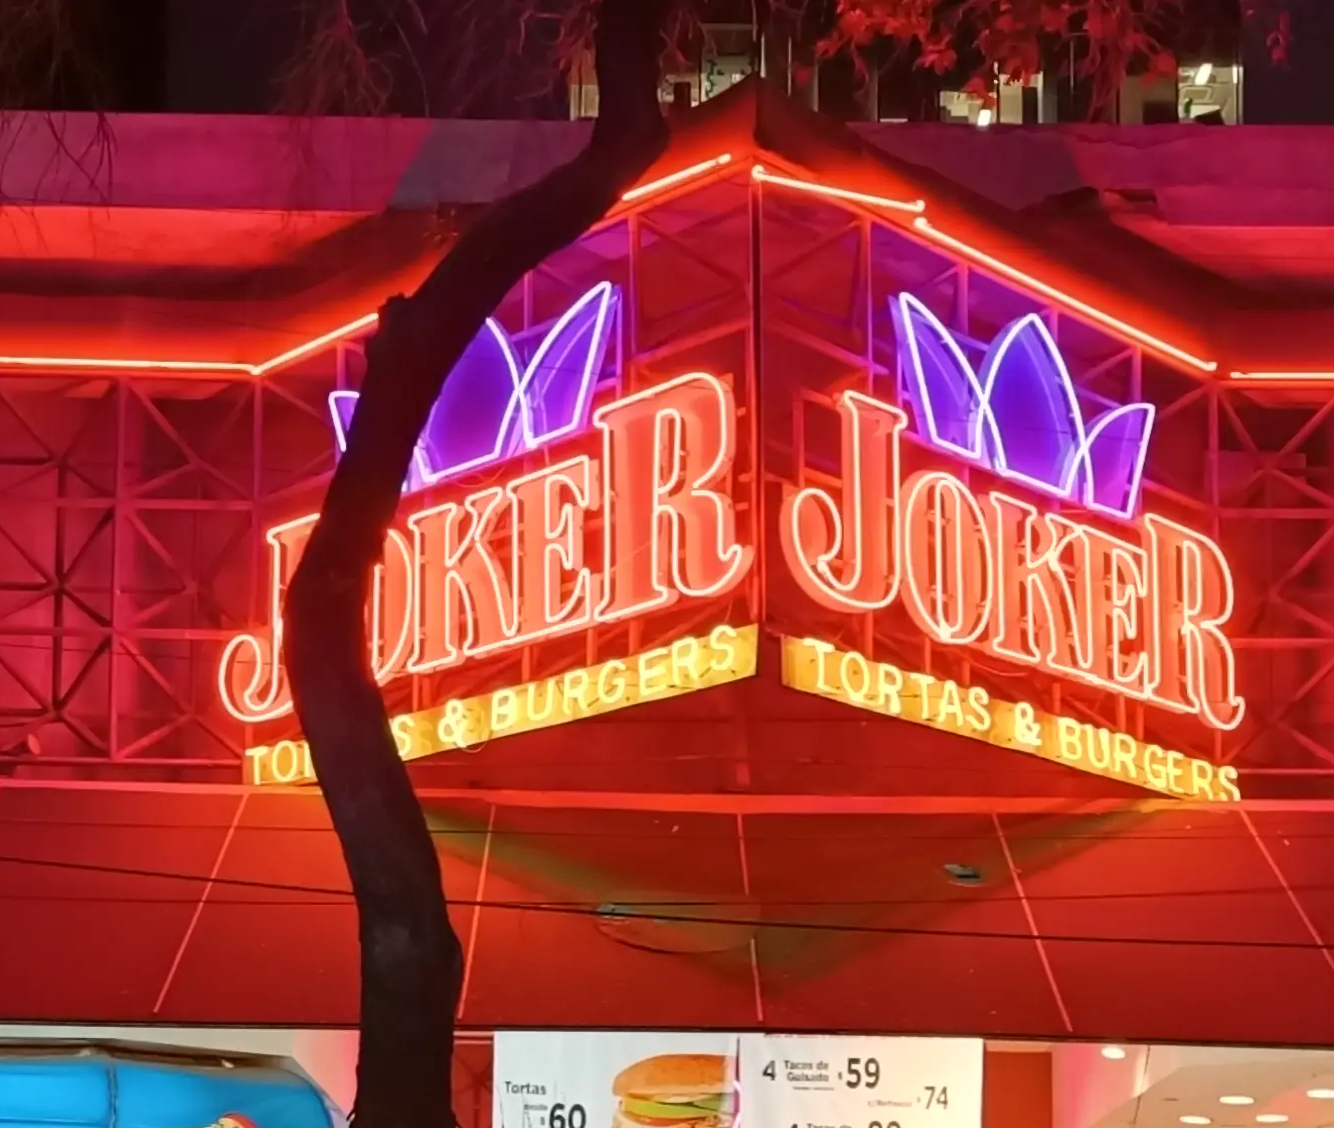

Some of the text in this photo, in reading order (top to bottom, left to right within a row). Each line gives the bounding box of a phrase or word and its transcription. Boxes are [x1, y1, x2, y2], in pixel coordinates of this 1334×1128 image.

[783, 390, 1245, 730] JOKER
[438, 699, 468, 748] &
[490, 626, 737, 733] BURGERS
[803, 637, 1242, 802] TORTAS & BURGERS
[504, 1081, 547, 1096] Tortas
[762, 1059, 829, 1081] 4 Tacos de
